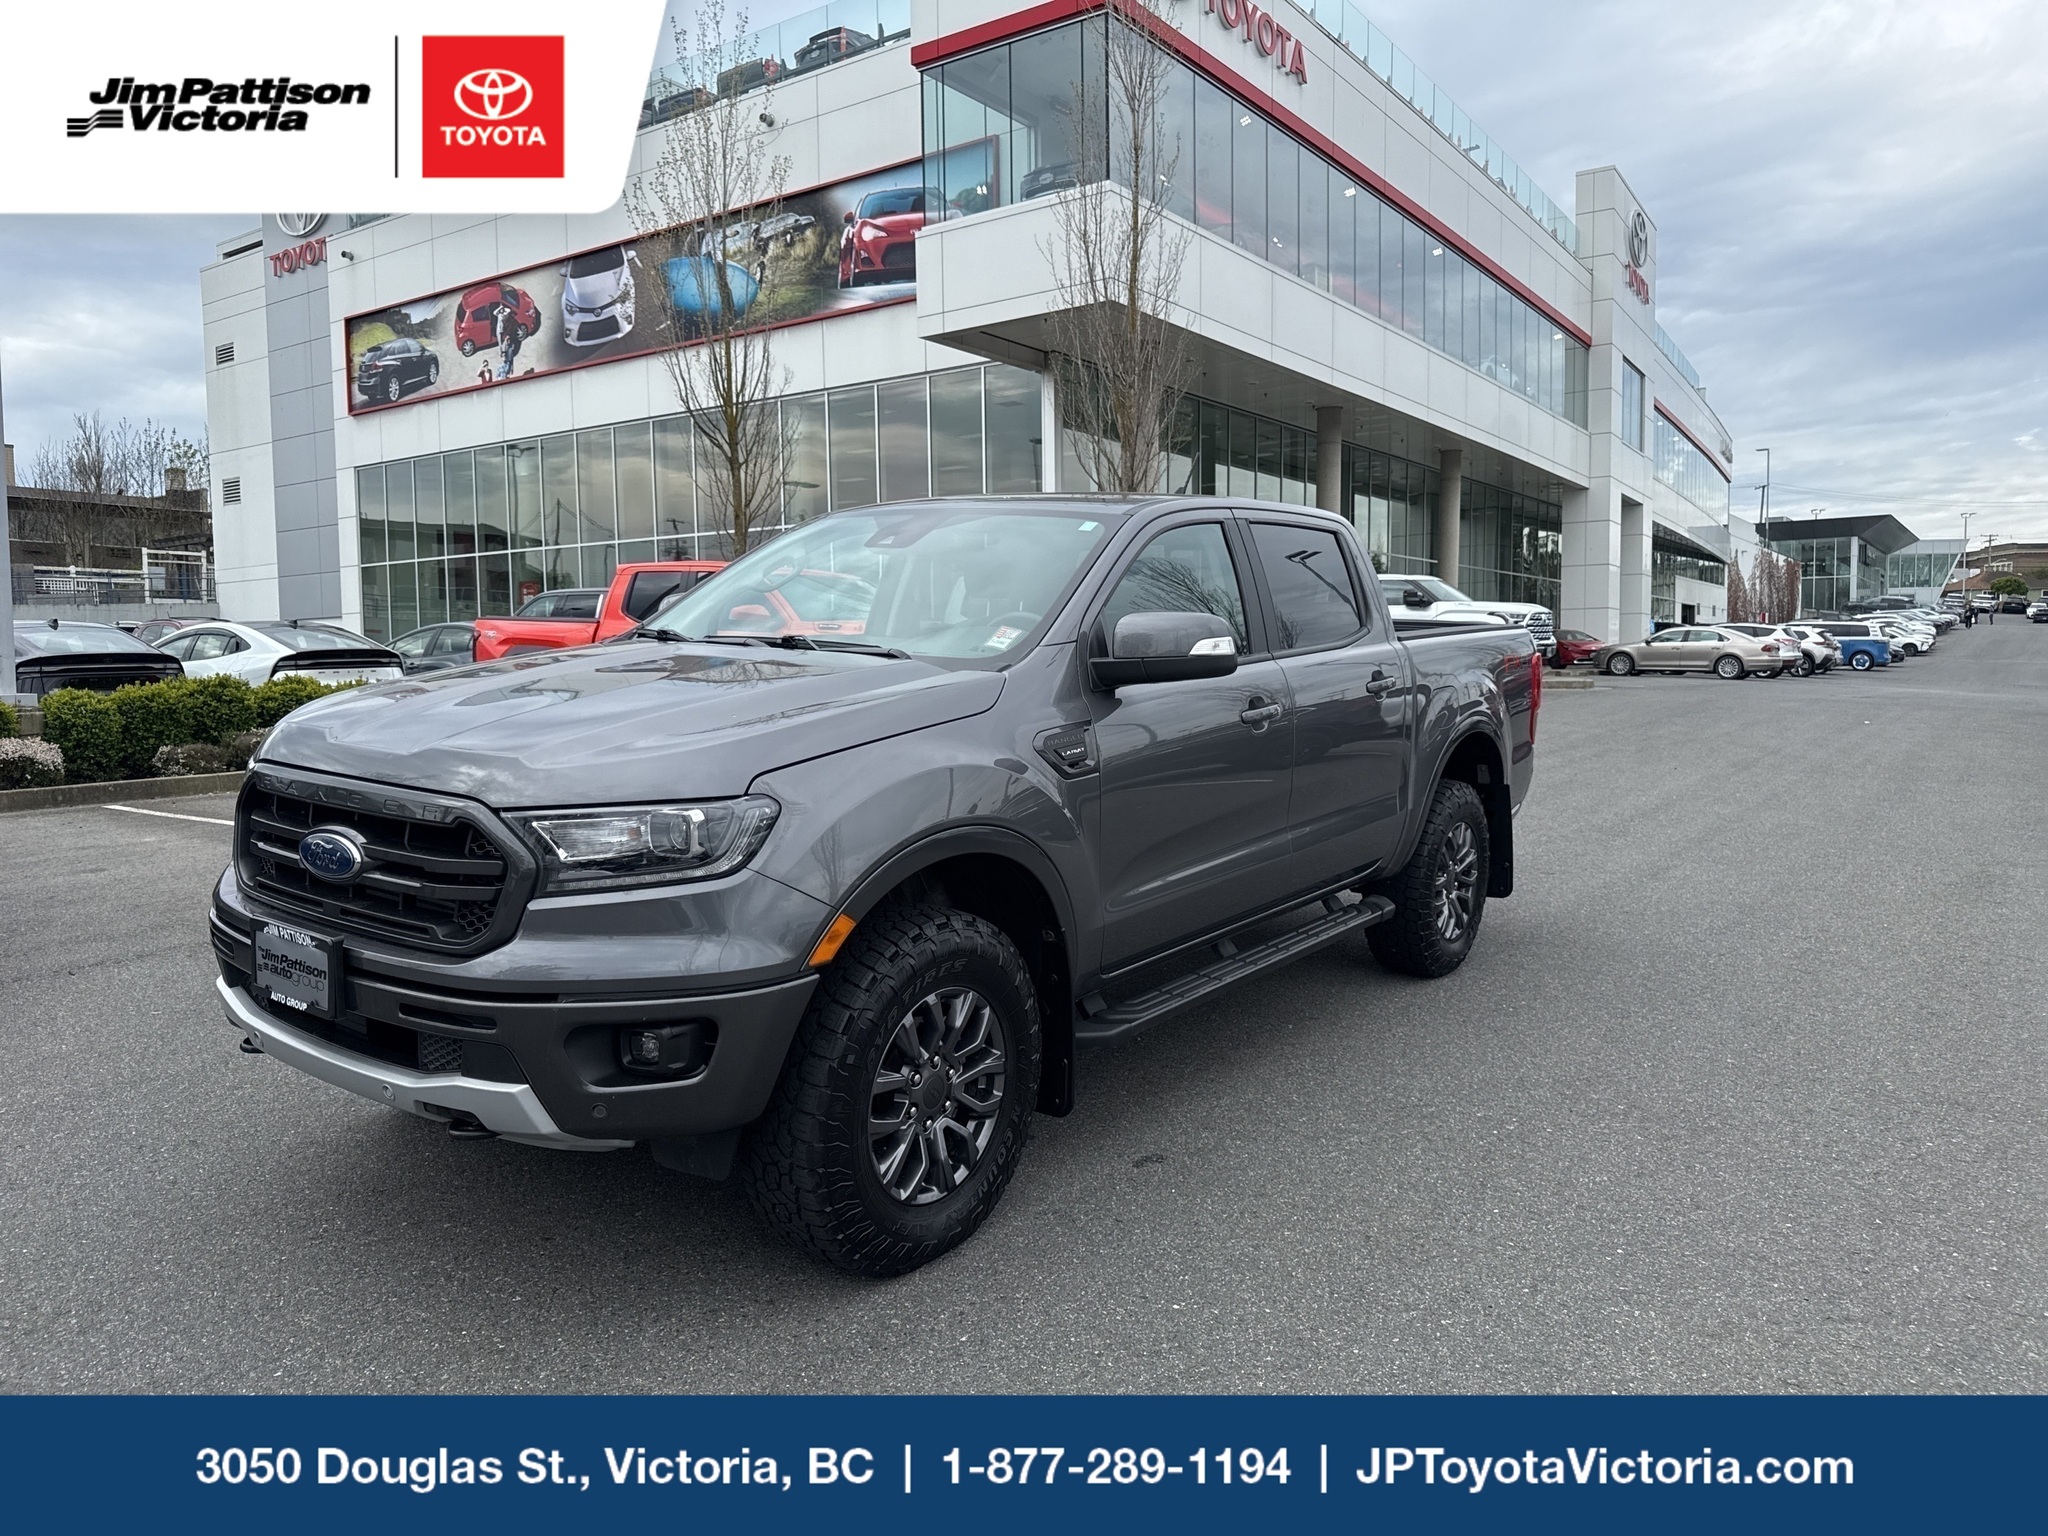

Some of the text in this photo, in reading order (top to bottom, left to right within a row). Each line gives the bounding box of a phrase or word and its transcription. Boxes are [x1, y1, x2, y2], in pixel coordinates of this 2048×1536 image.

[269, 235, 328, 278] TOYOT
[307, 839, 341, 869] Ford
[280, 926, 312, 946] PATTISON
[270, 991, 308, 1012] AUTO GROUP
